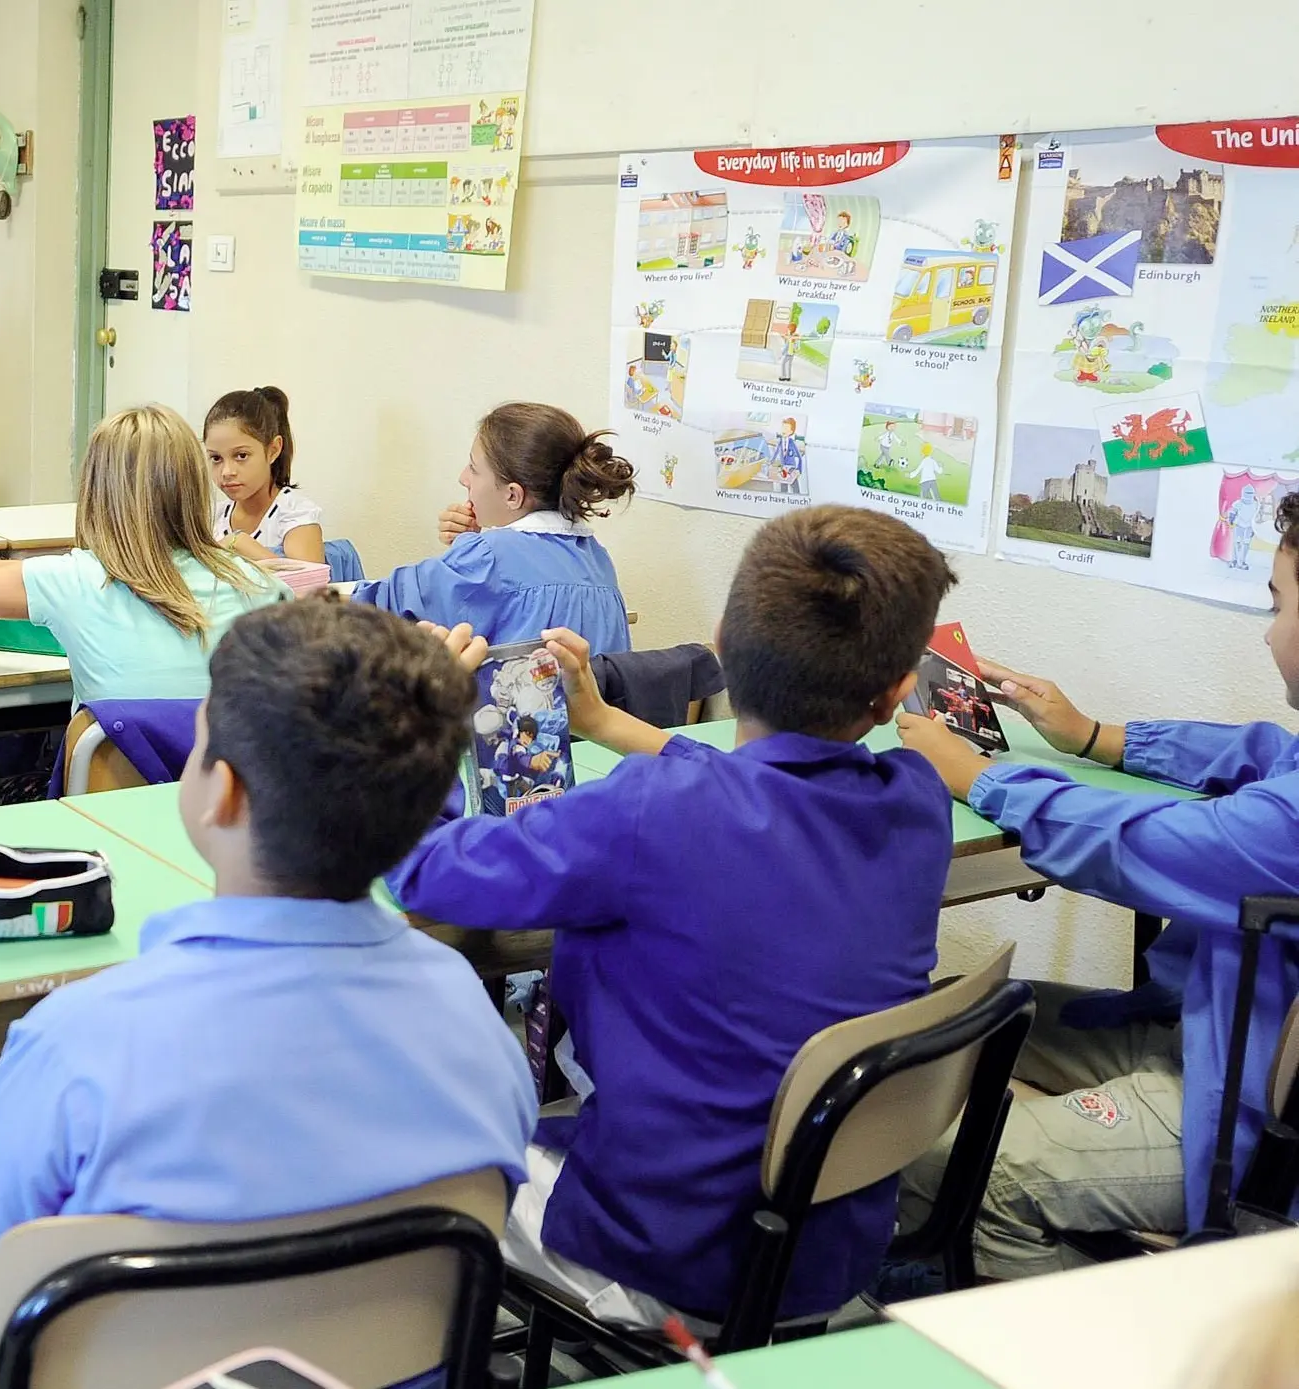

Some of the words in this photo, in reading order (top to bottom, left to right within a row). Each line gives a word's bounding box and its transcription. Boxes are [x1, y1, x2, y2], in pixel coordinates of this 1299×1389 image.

[162, 130, 195, 161] ECCO
[313, 130, 340, 146] lunghezza
[1211, 128, 1253, 148] The
[717, 152, 777, 174] Everyday
[781, 149, 801, 172] life
[802, 151, 815, 169] in
[818, 147, 885, 173] England
[695, 272, 712, 280] live?
[1138, 269, 1201, 282] Edinburgh
[779, 276, 800, 286] What
[802, 279, 812, 287] do
[813, 281, 827, 290] you
[829, 280, 848, 290] have
[849, 282, 860, 292] for
[797, 290, 836, 300] breakfast?
[953, 298, 976, 307] SCHOOL
[1260, 314, 1296, 324] IRELAND
[890, 344, 912, 354] How
[914, 347, 926, 356] do
[929, 350, 946, 360] you
[948, 353, 964, 362] get
[915, 360, 950, 370] school?
[742, 381, 764, 392] What
[766, 385, 784, 394] time
[785, 386, 796, 396] do
[796, 390, 816, 399] your
[752, 393, 779, 404] lessons
[780, 397, 802, 408] start?
[634, 412, 650, 422] What
[652, 415, 660, 424] do
[660, 420, 672, 429] you
[642, 425, 662, 435] study?
[716, 490, 741, 500] Where
[742, 493, 752, 501] do
[754, 496, 768, 504] you
[769, 496, 786, 504] have
[787, 496, 812, 506] lunch?
[860, 489, 885, 502] What
[887, 494, 900, 505] do
[901, 498, 918, 509] you
[921, 502, 933, 510] do
[936, 503, 944, 513] in
[948, 506, 963, 516] the
[894, 506, 925, 520] break?
[1058, 550, 1095, 564] Cardiff
